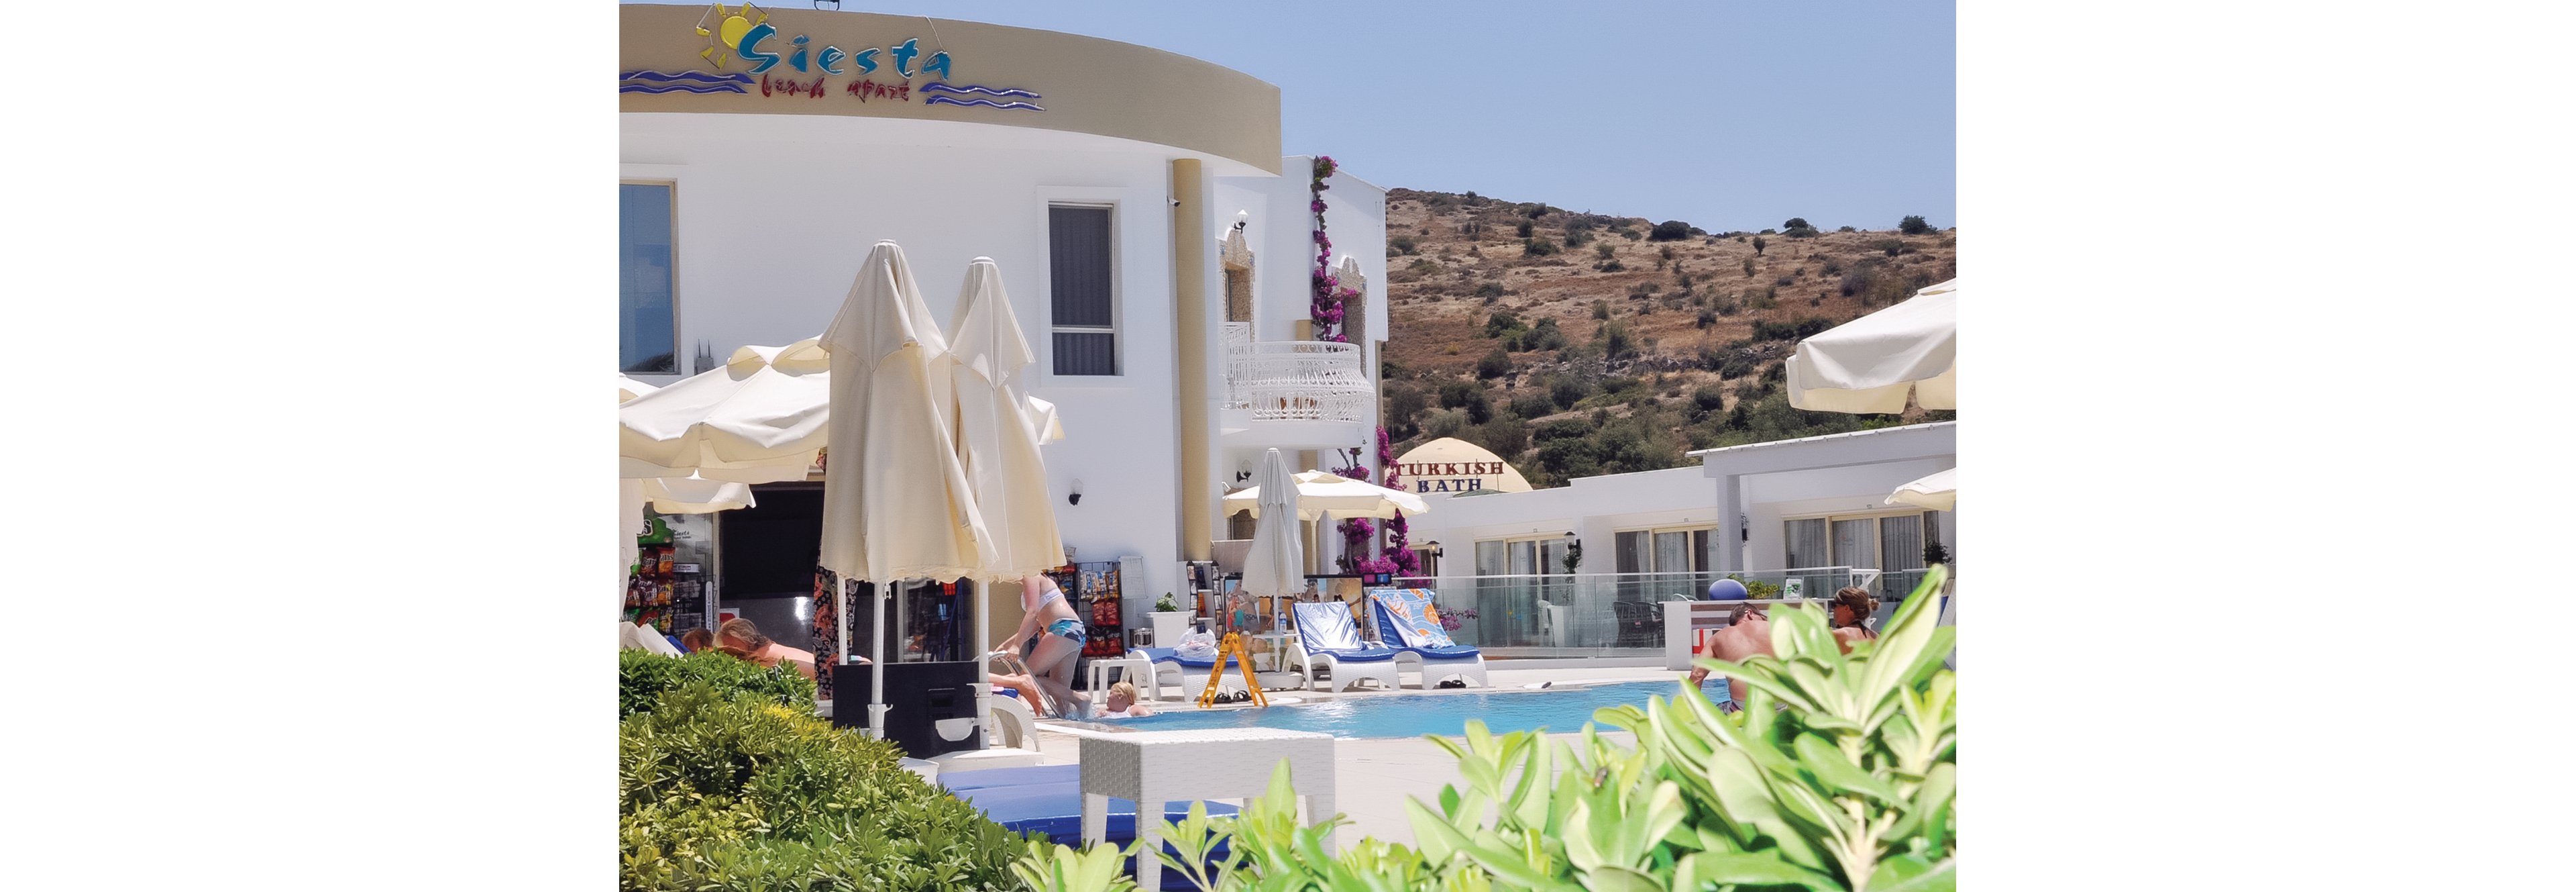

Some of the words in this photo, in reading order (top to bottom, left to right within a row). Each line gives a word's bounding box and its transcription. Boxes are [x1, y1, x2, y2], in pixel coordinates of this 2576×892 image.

[737, 23, 953, 81] Siesta
[847, 79, 911, 103] apart
[1397, 462, 1504, 476] TURKISH
[1417, 479, 1481, 493] BATH
